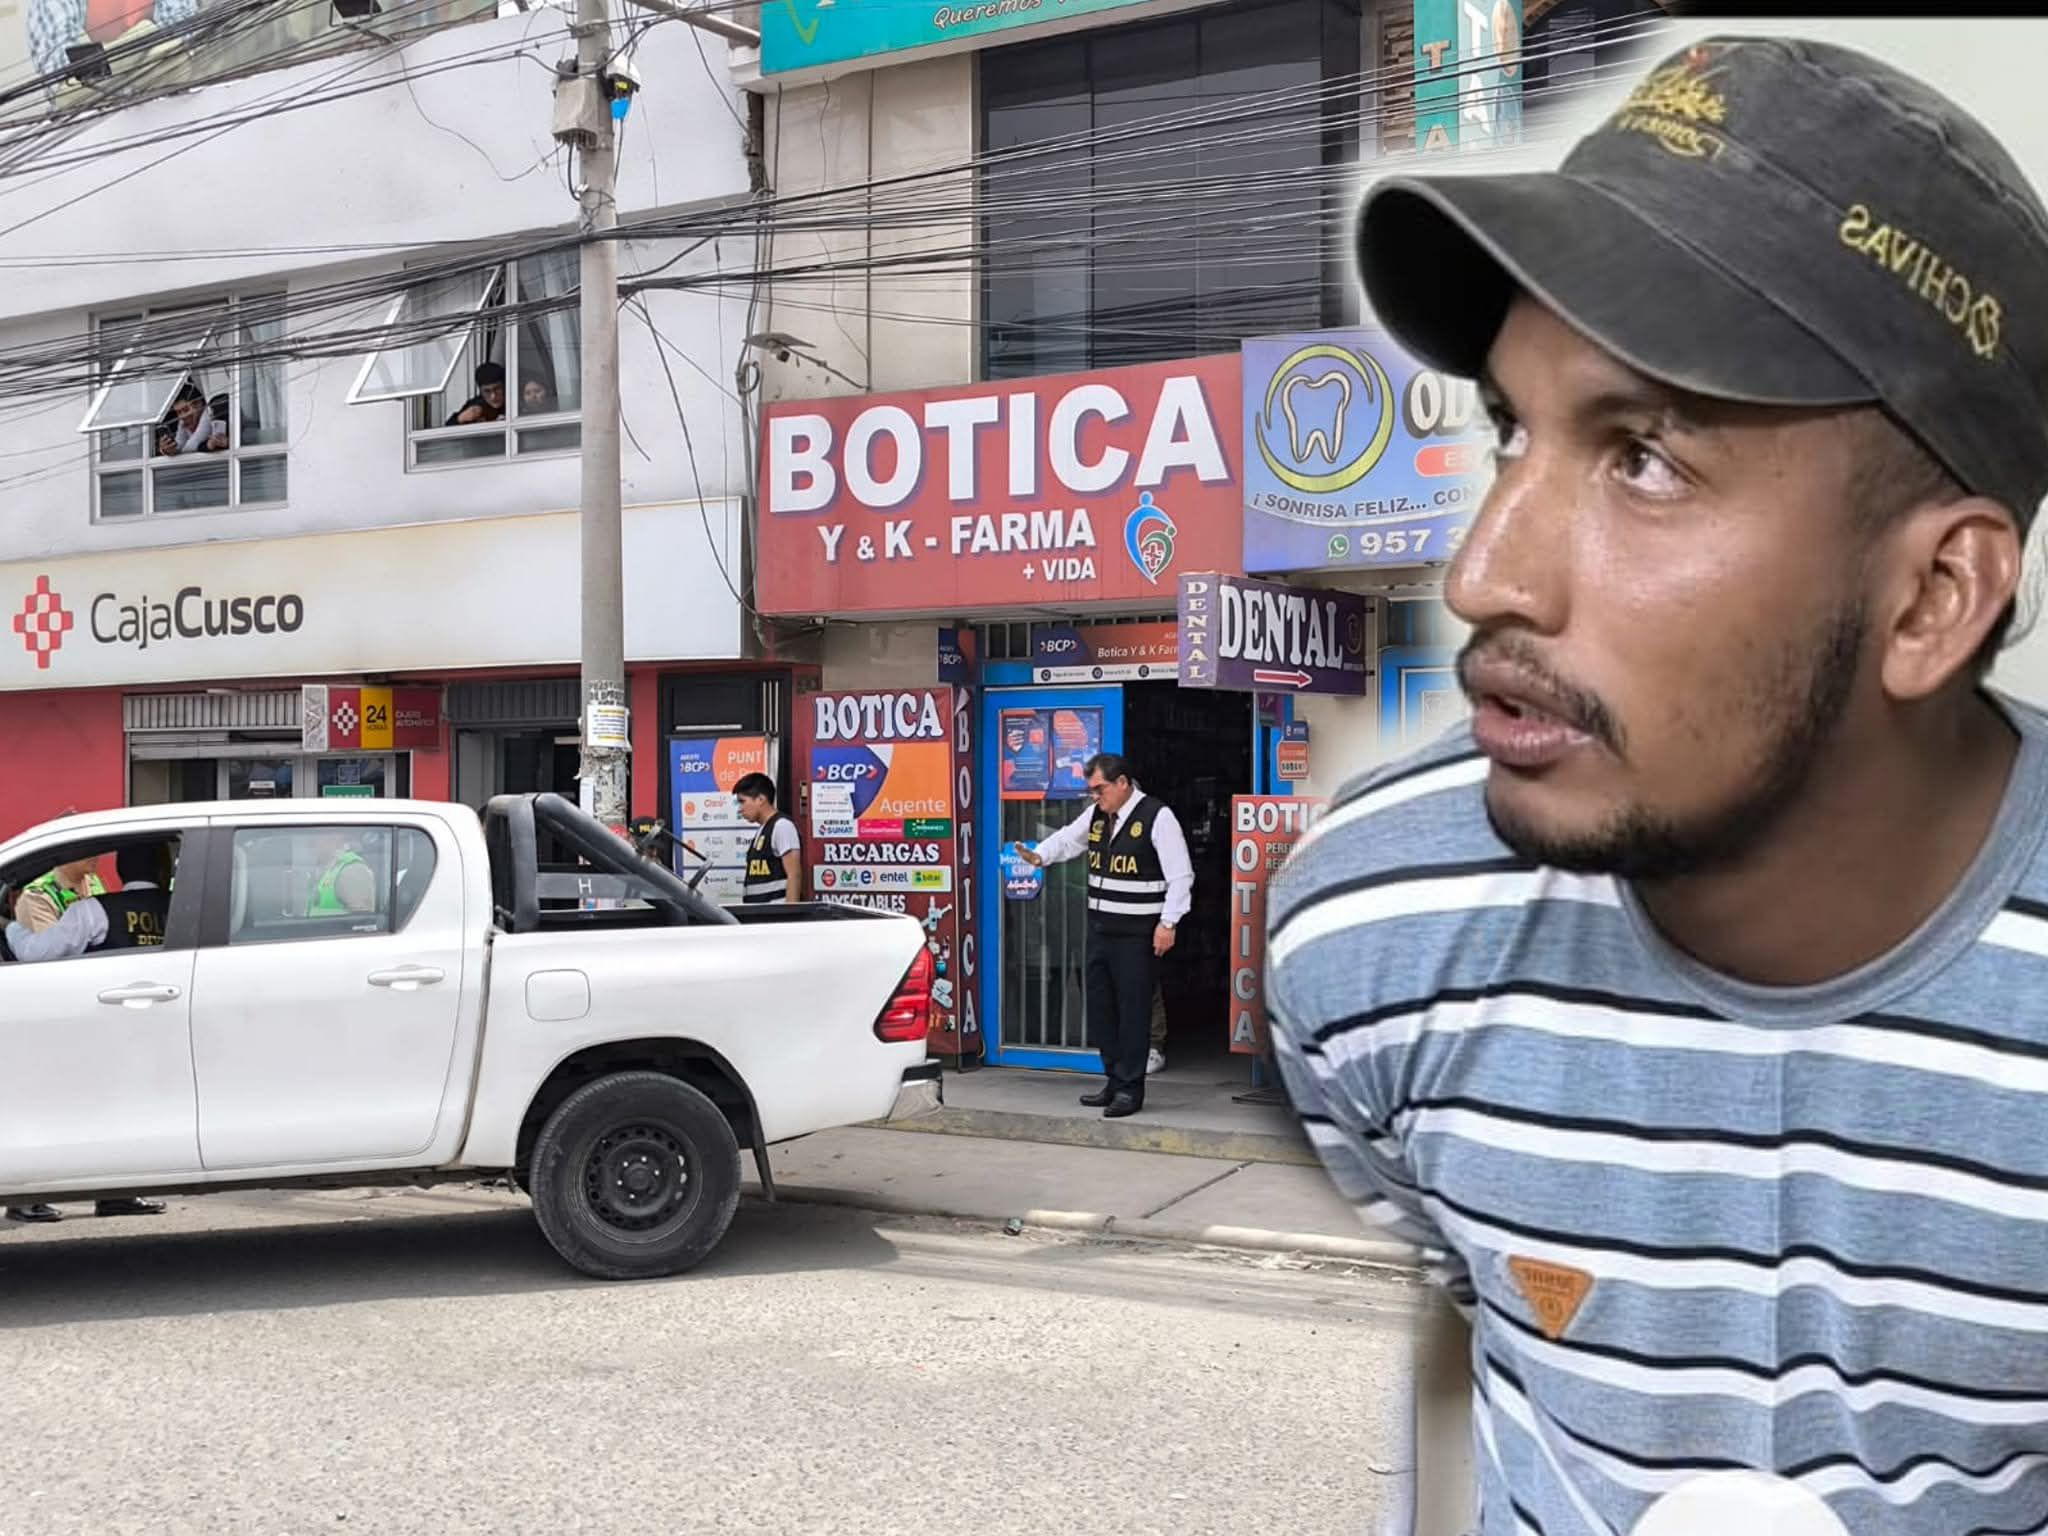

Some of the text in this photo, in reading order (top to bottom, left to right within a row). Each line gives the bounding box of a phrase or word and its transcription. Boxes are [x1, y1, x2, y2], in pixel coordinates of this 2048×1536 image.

[769, 375, 1228, 513] BOTICA
[1265, 494, 1347, 518] SONRISA
[1354, 498, 1427, 517] FELIZ...
[817, 524, 844, 562] Y
[856, 535, 875, 560] &
[884, 520, 913, 558] K
[951, 508, 1096, 554] FARMA
[1359, 529, 1431, 554] 957
[1022, 557, 1096, 581] + VIDA
[91, 587, 304, 650] CajaCusco
[1186, 581, 1208, 680] DENTAL
[1218, 584, 1343, 670] DENTAL
[1046, 639, 1071, 653] BCP
[1097, 646, 1128, 658] Botica
[1130, 645, 1137, 656] Y
[1139, 644, 1146, 656] &
[1149, 643, 1157, 656] K
[366, 704, 388, 724] 24
[815, 691, 944, 740] BOTICA
[685, 761, 705, 773] BCP
[827, 763, 867, 781] BCP
[879, 798, 946, 817] Agente
[1236, 801, 1330, 833] BOTIC
[823, 842, 940, 863] RECARGAS
[880, 872, 909, 883] entel
[957, 711, 977, 1034] BOTICA
[126, 911, 164, 934] POL
